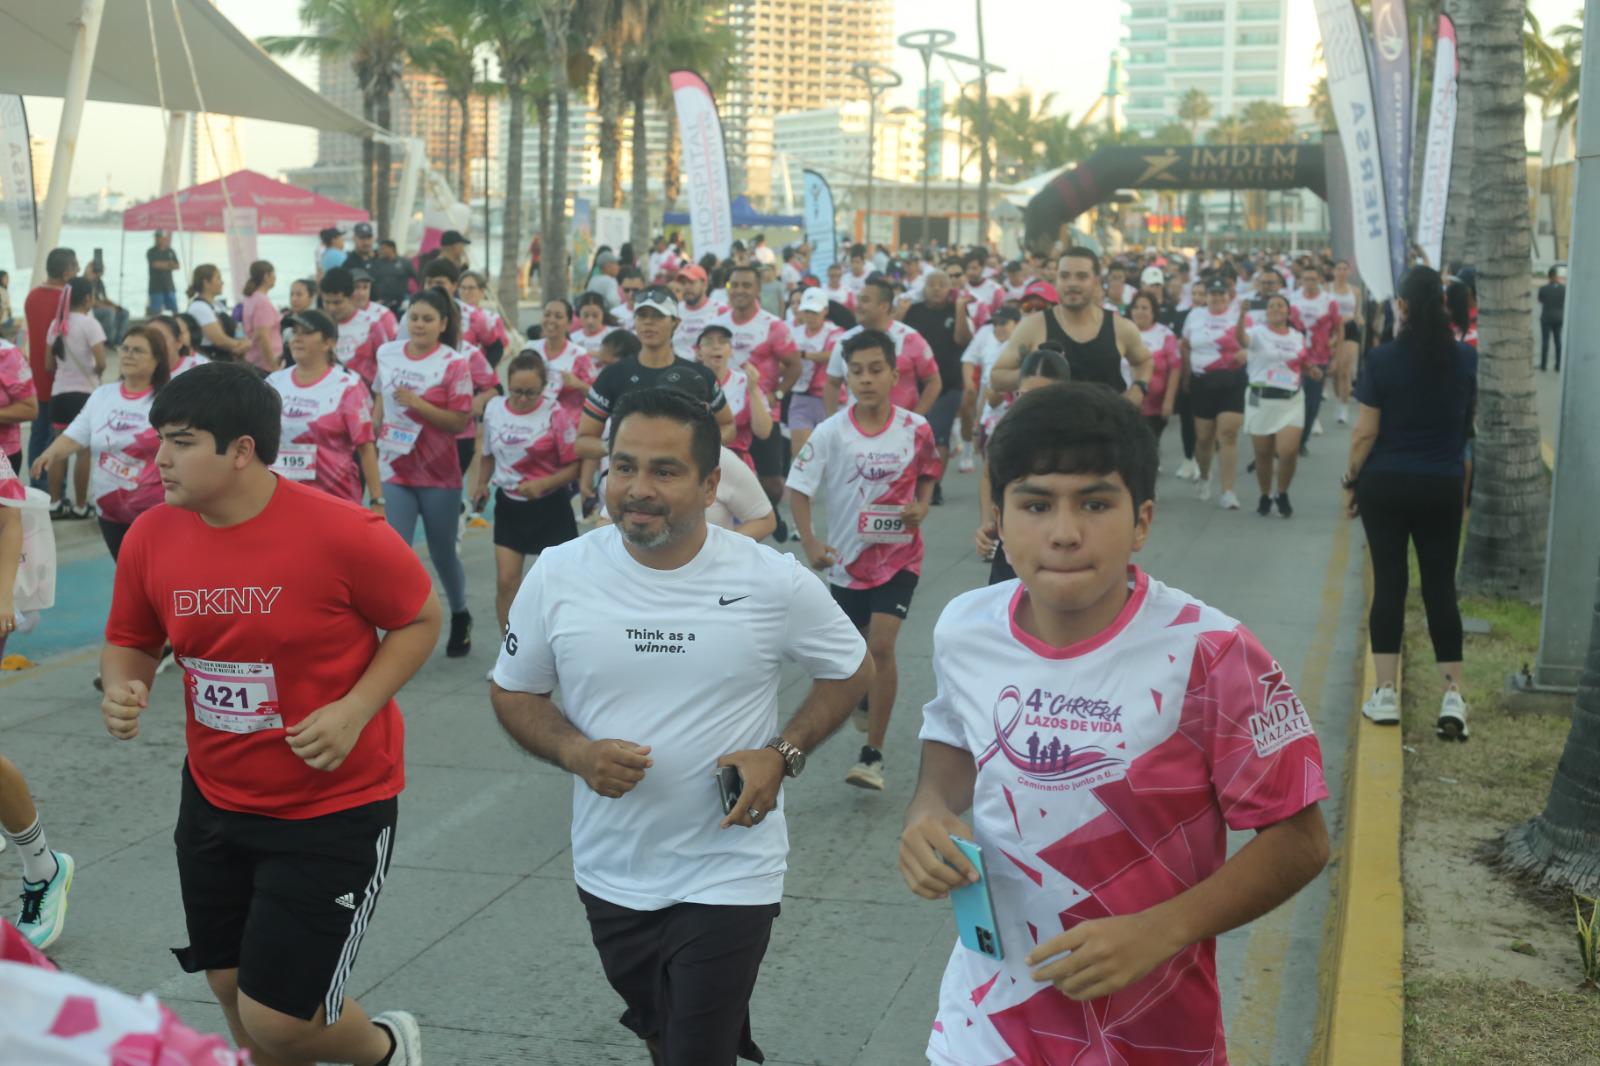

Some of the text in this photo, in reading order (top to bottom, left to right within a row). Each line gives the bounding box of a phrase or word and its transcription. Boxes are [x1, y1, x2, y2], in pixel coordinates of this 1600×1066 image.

[1191, 147, 1299, 167] IMDEM
[687, 122, 713, 247] HOSPITAL
[282, 456, 305, 467] 195
[873, 518, 903, 531] 099
[173, 586, 283, 617] DKNY
[625, 628, 696, 641] Think as a
[634, 641, 686, 654] winner.
[204, 684, 249, 709] 421
[1049, 694, 1122, 722] CARRERA
[1025, 713, 1123, 733] LAZOS DE VIDA
[1017, 776, 1070, 792] Caminando
[1072, 775, 1096, 791] junto
[1096, 773, 1104, 781] a
